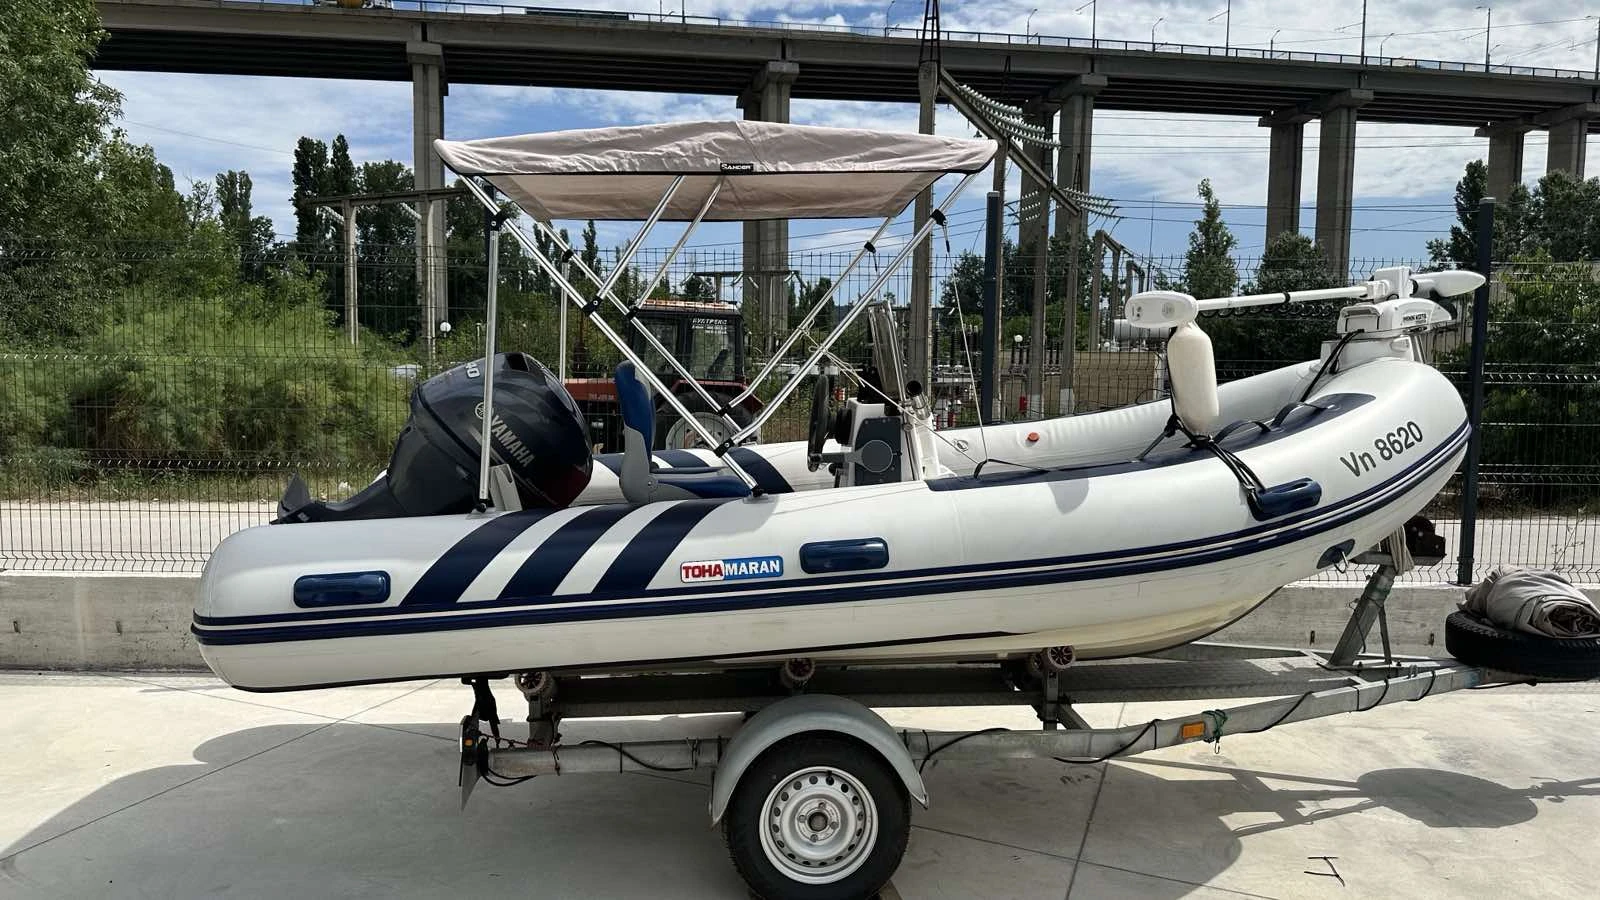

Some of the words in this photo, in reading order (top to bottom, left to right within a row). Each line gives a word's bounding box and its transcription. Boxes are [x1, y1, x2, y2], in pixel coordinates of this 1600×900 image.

[491, 414, 536, 468] YAMAHA
[1339, 451, 1377, 477] Vn
[1374, 421, 1423, 461] 8620
